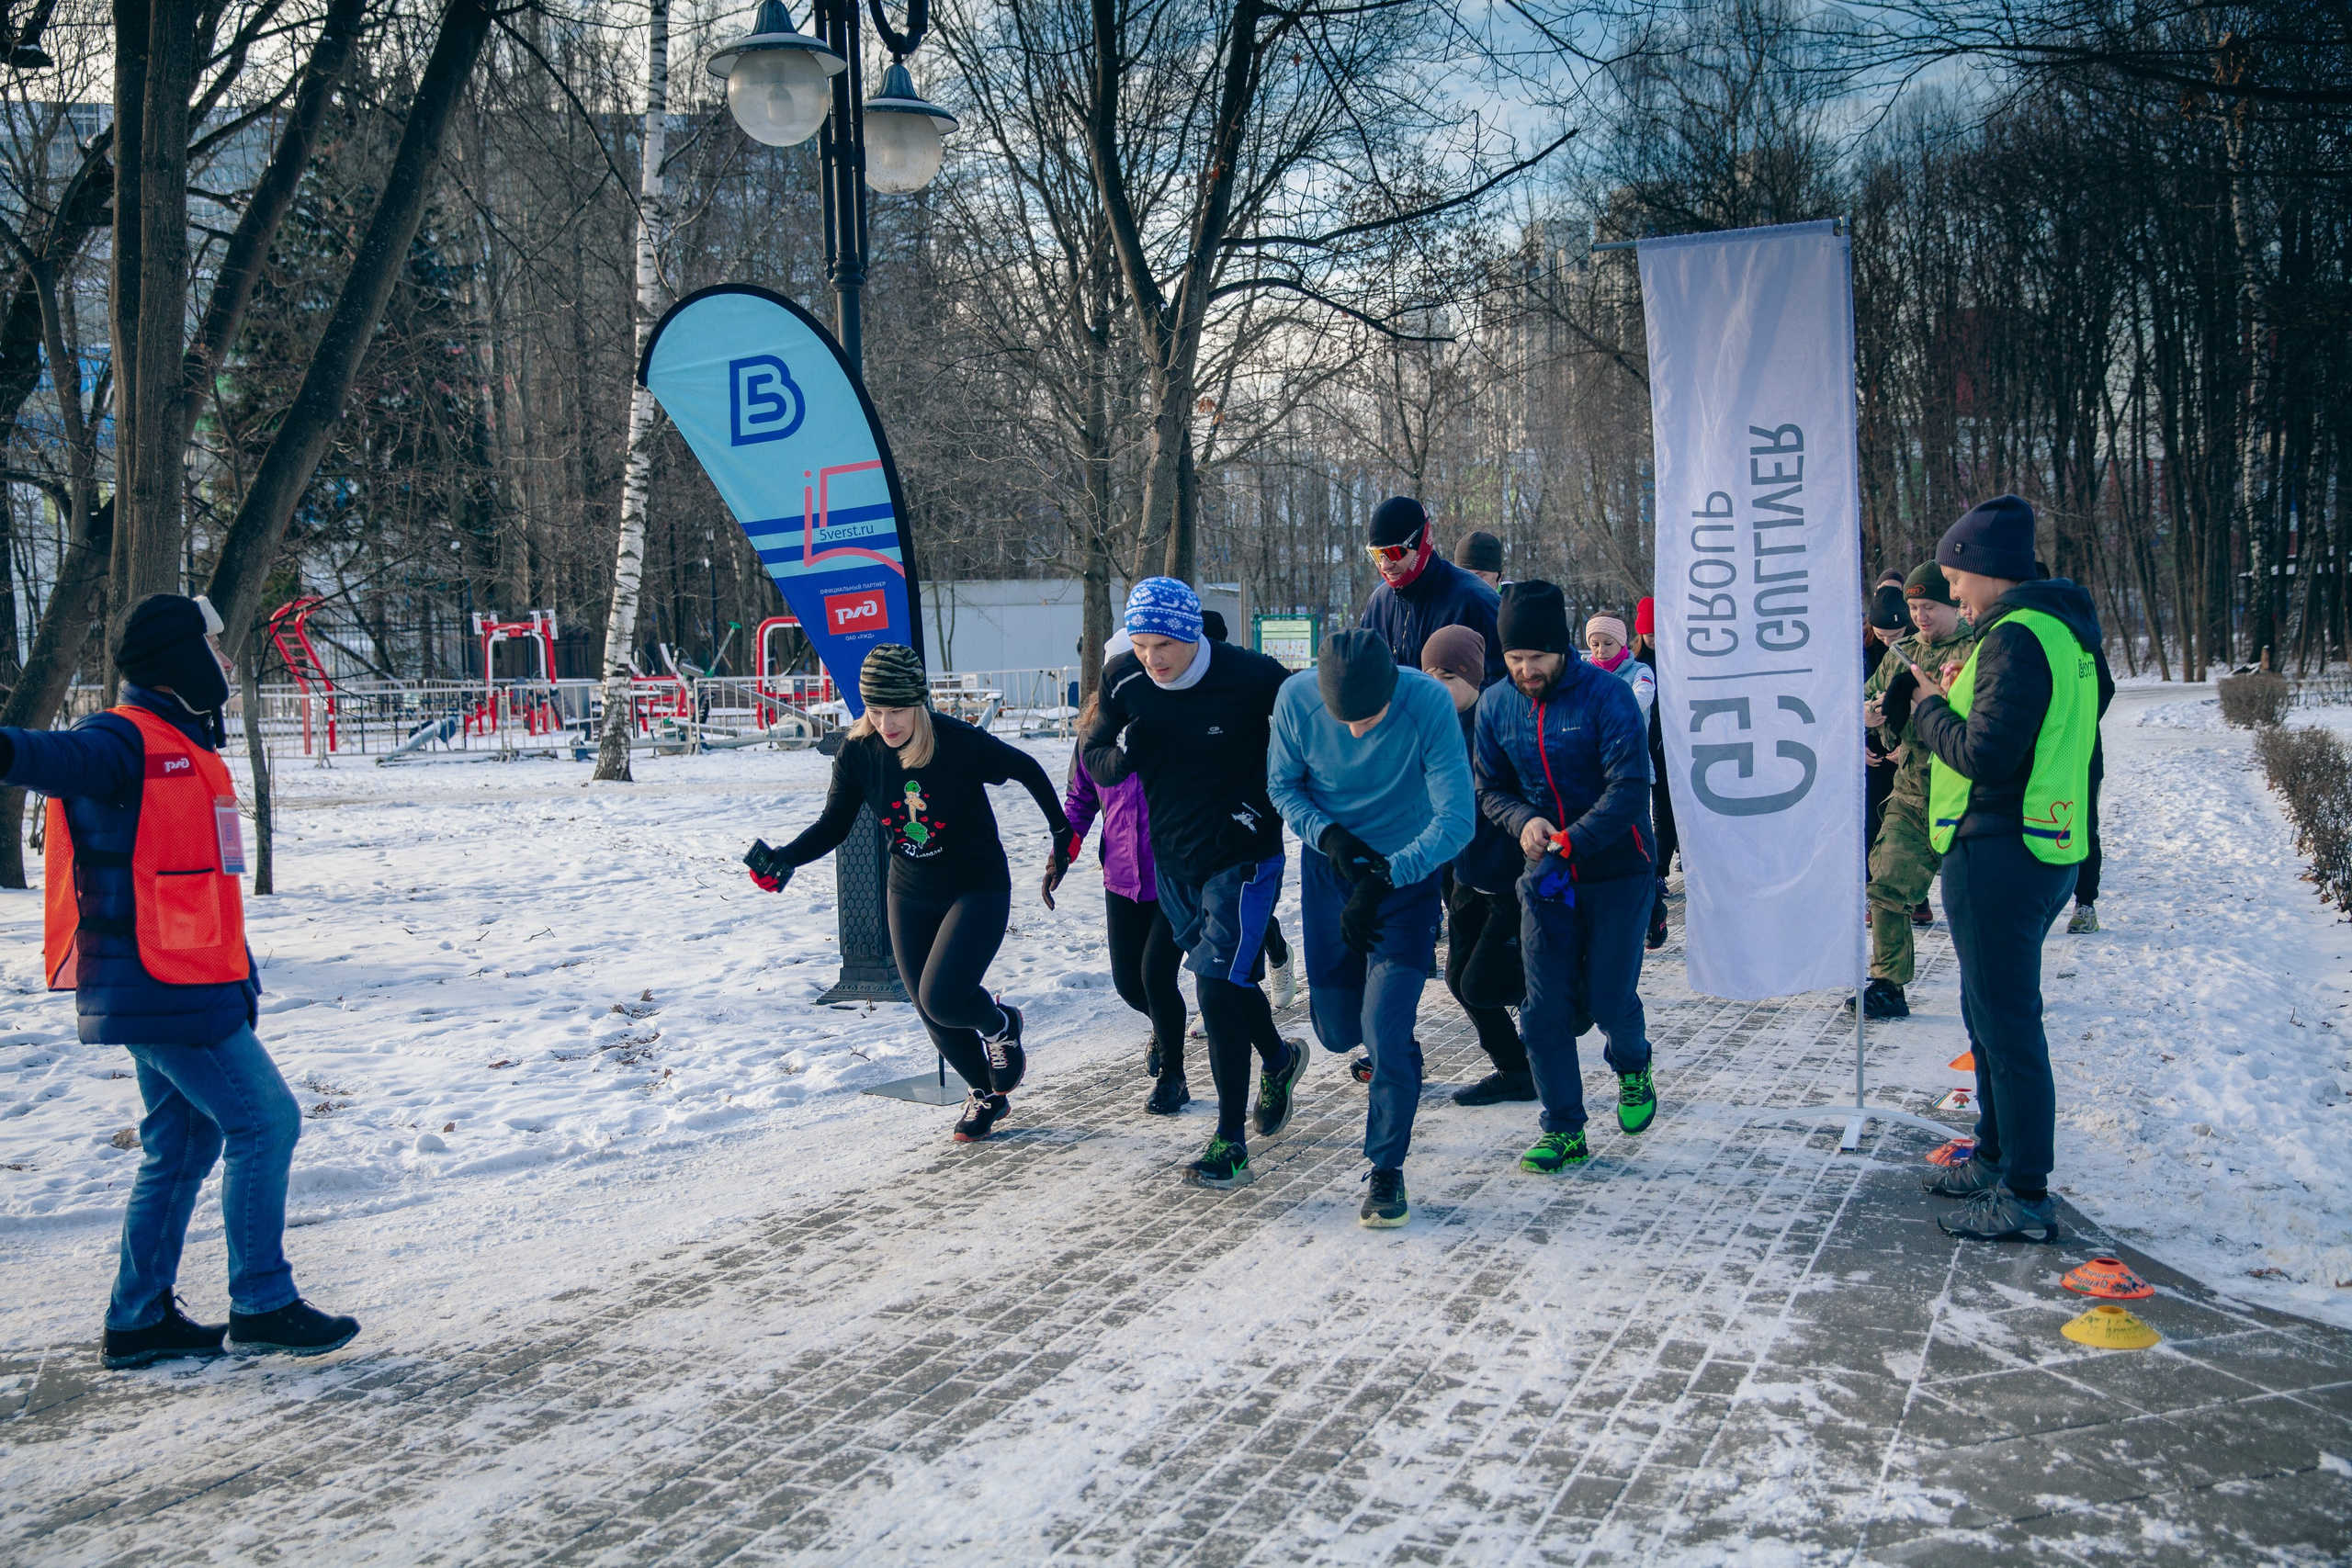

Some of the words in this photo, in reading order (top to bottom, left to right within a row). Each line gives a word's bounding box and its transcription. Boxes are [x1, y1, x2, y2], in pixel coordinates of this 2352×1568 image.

[820, 525, 874, 541] 5verst.ru
[820, 583, 862, 595] ОФИЦИАЛЬНЫЙ
[863, 581, 887, 589] ПАРТНЕР
[902, 842, 917, 857] 23
